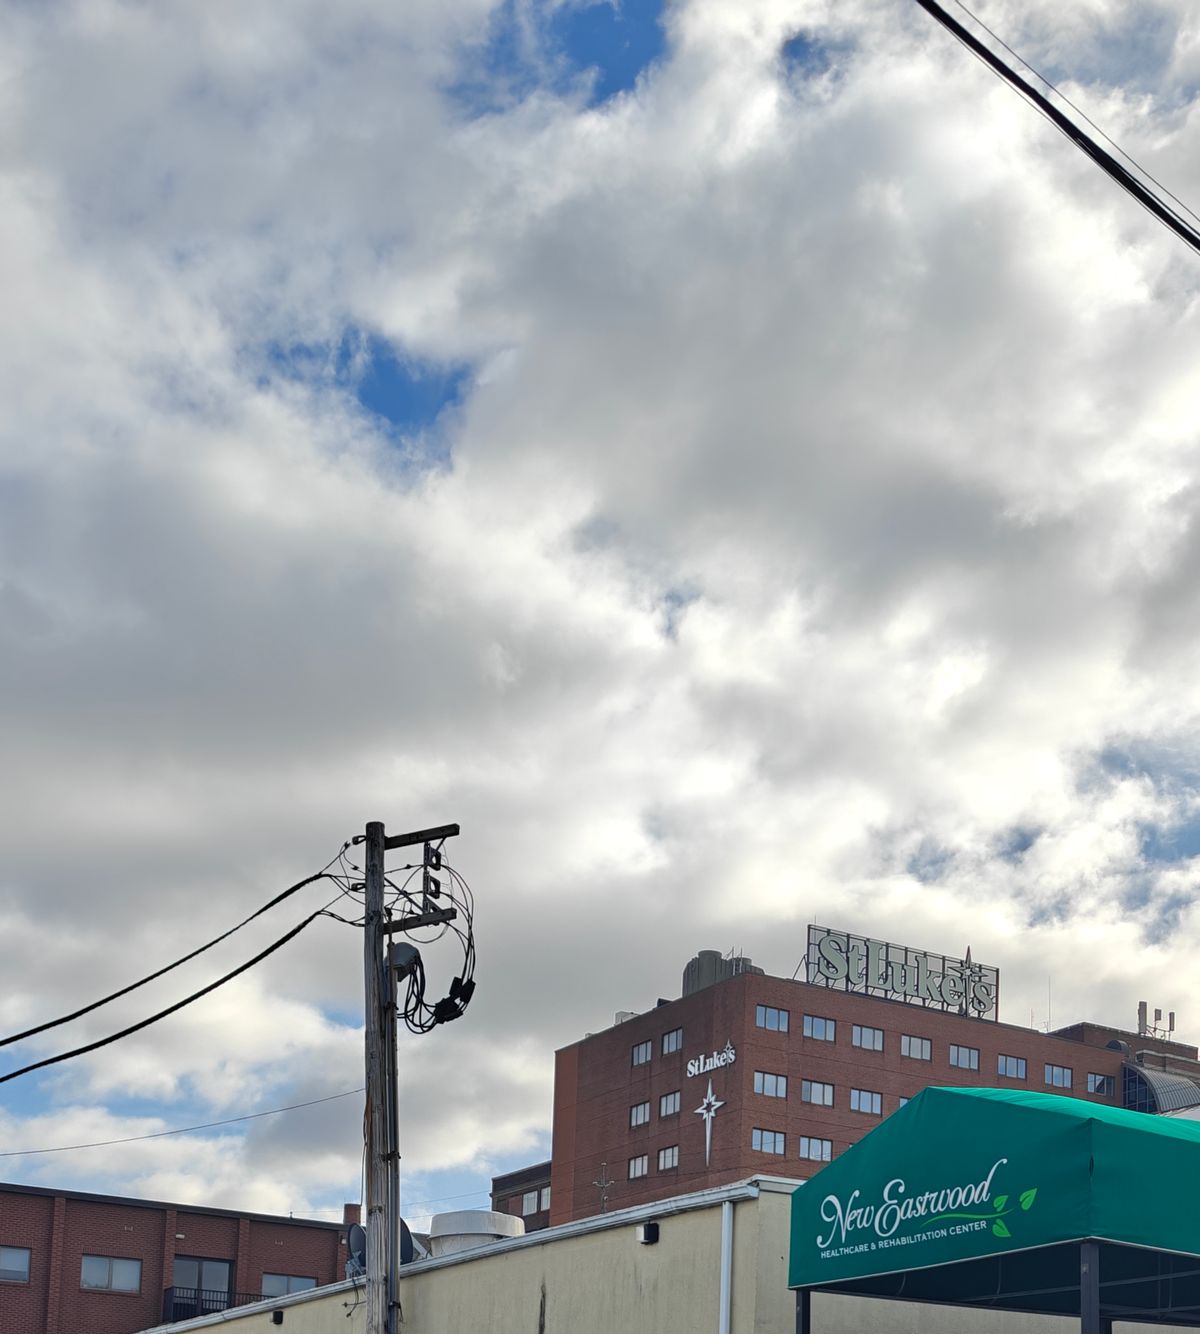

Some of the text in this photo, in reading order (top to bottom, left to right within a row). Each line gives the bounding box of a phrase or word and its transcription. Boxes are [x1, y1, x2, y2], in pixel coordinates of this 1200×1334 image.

[816, 1158, 1008, 1249] New Eastwood
[820, 1220, 988, 1259] HEALTHCARE & REHABILITATION CENTER
